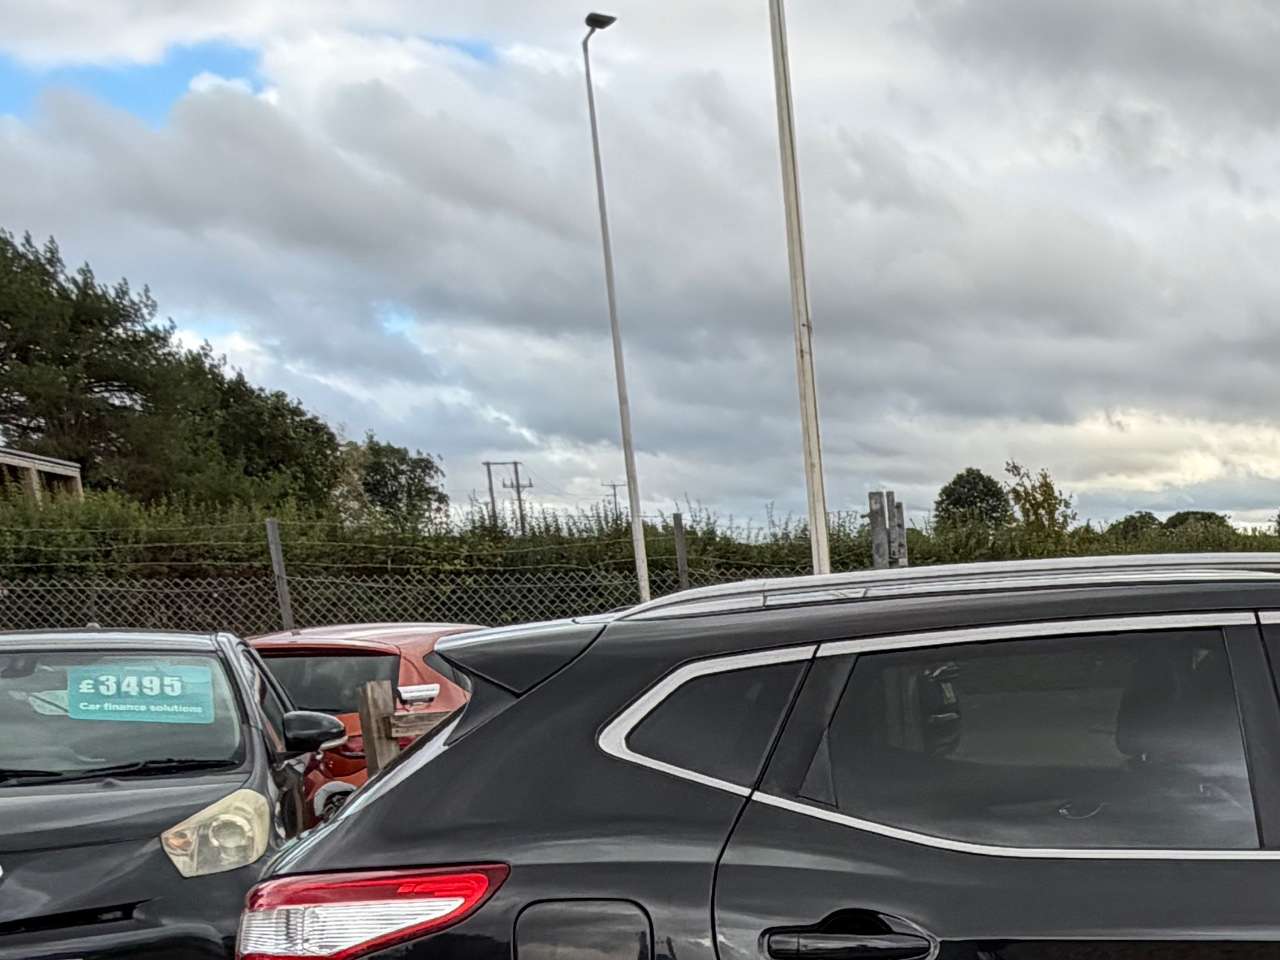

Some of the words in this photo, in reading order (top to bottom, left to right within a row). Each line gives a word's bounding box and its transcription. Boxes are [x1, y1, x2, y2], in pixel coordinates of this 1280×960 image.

[79, 675, 182, 697] £3495
[79, 702, 101, 711] Car
[103, 702, 147, 712] finance
[149, 704, 203, 713] solutions
